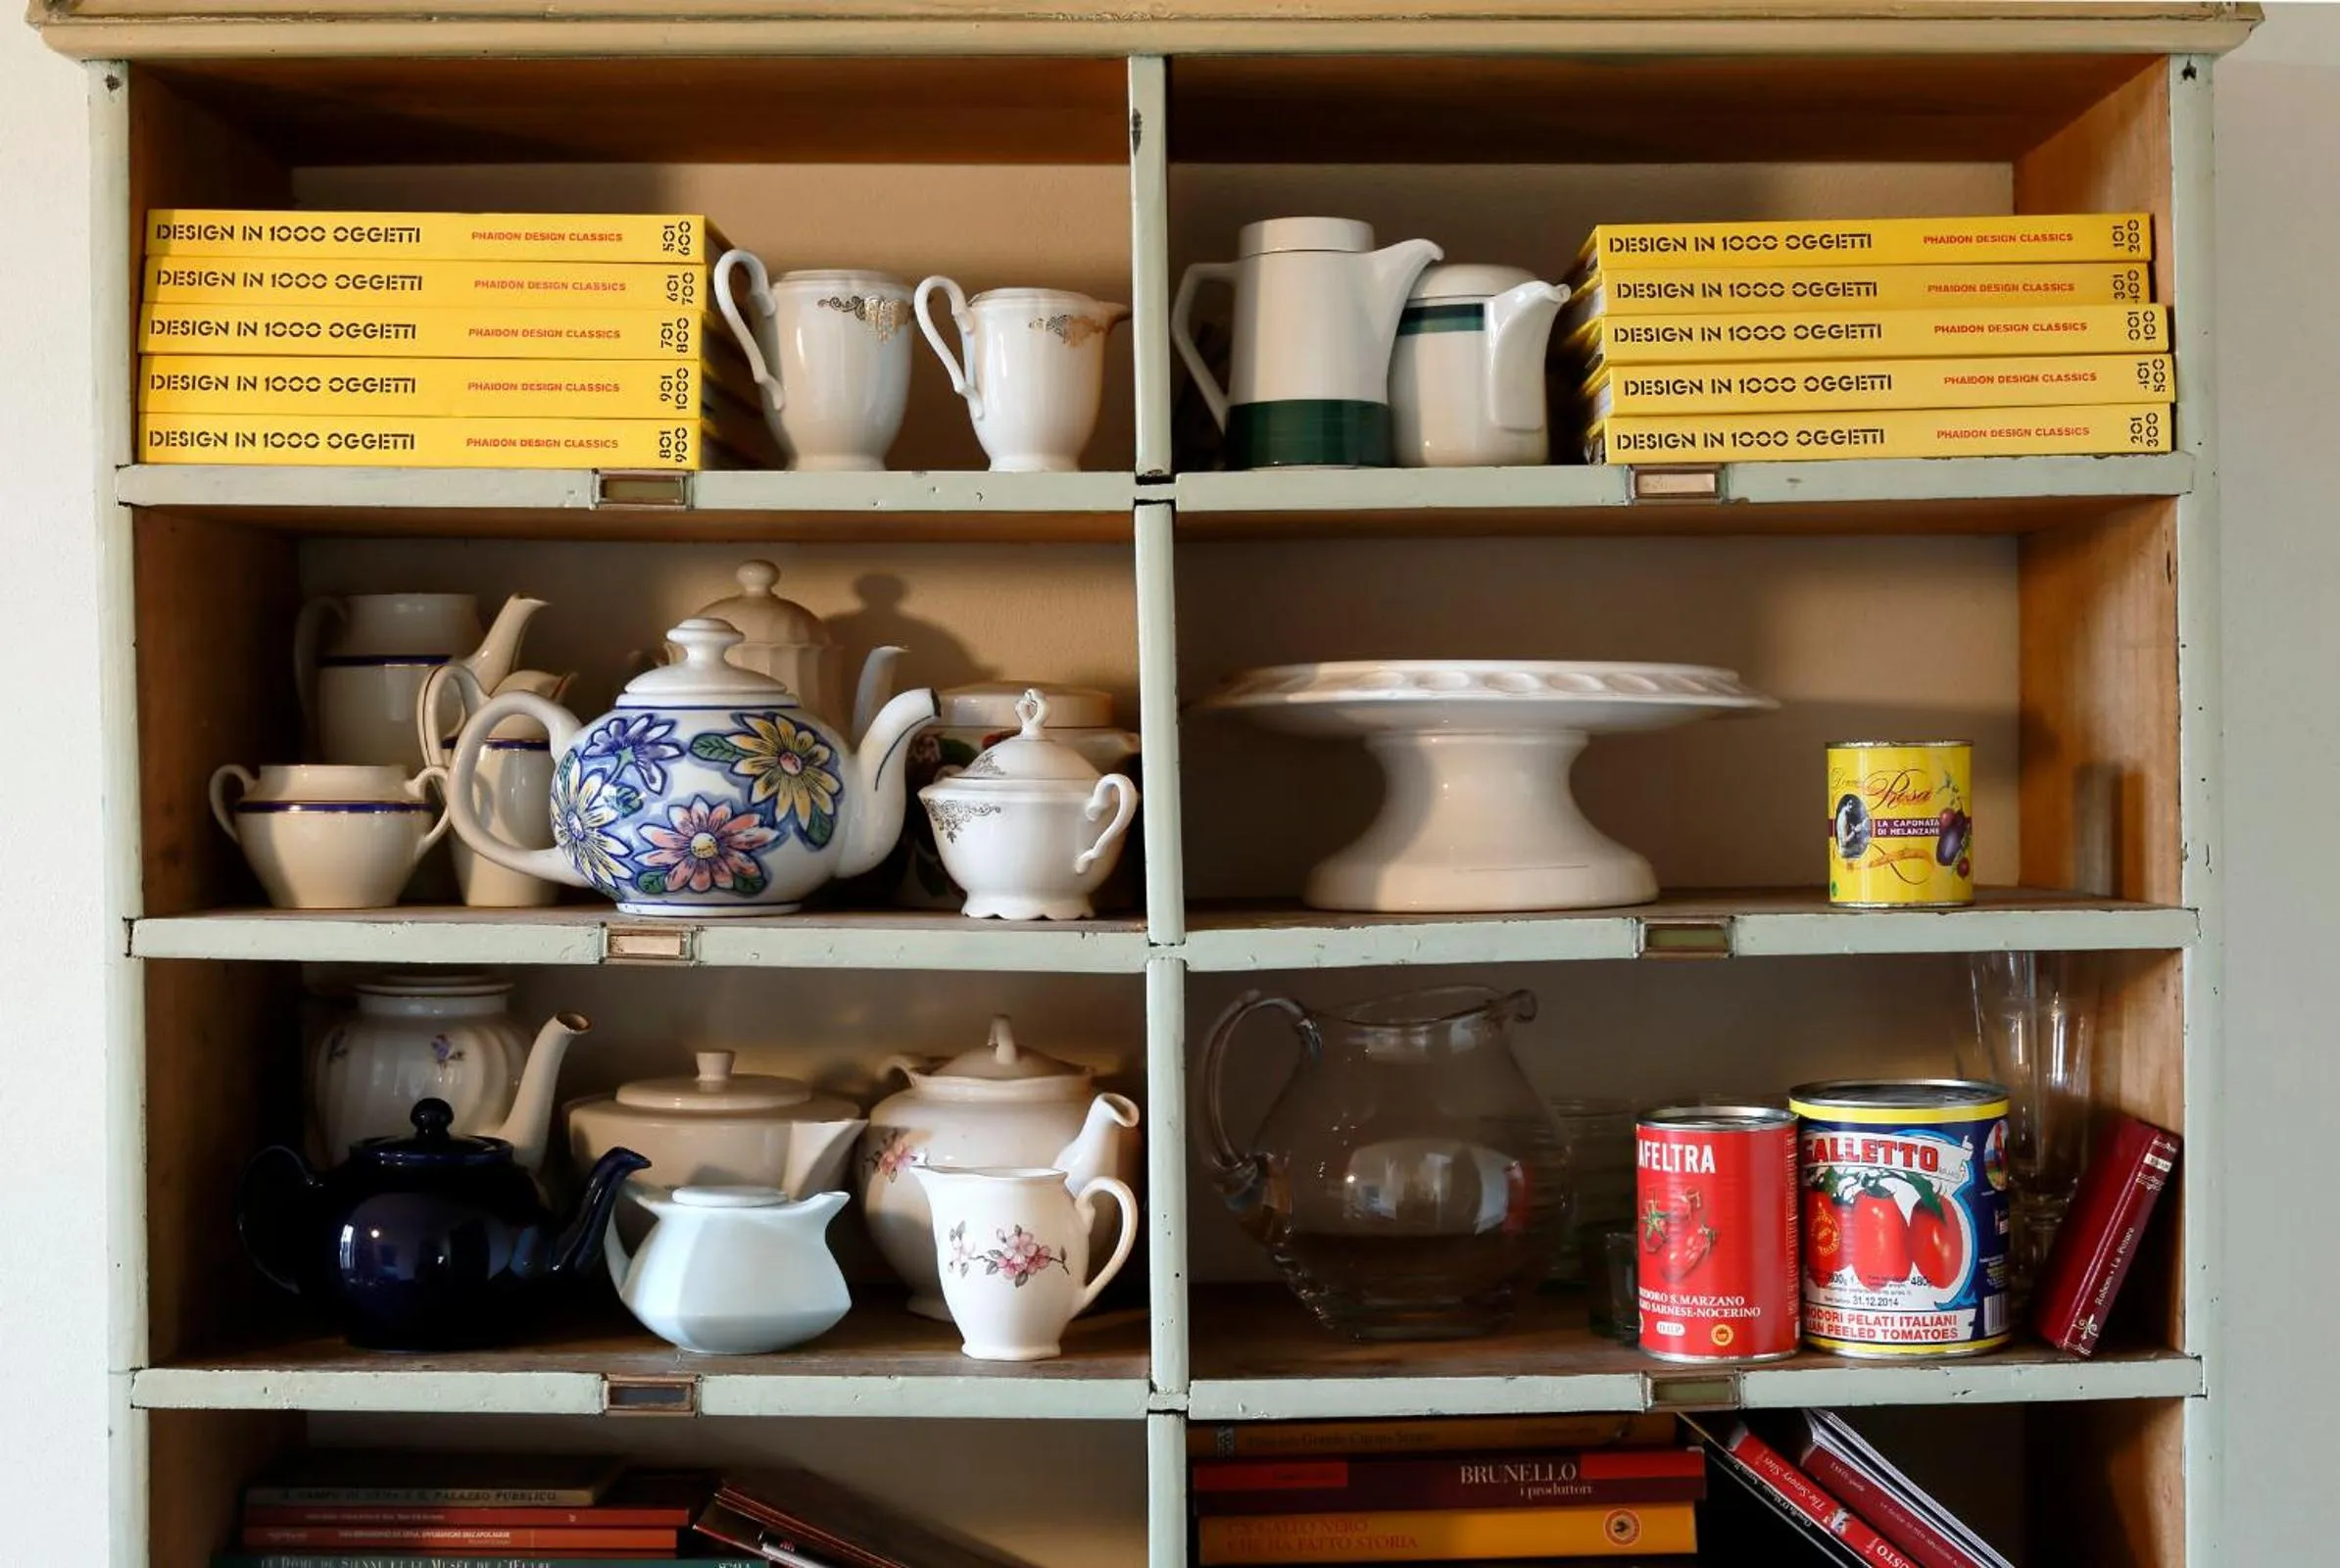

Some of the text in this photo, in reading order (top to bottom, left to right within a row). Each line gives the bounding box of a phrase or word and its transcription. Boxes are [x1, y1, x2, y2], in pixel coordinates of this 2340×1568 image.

[157, 223, 419, 242] DESIGN IN 1000 OGGETTI
[525, 232, 564, 241] DESIGN
[663, 225, 675, 251] 501
[678, 221, 691, 256] 600
[1610, 233, 1872, 252] DESIGN IN 1000 OGGETTI
[1924, 235, 1973, 244] PHAIDON
[2020, 233, 2073, 242] CLASSICS
[2113, 225, 2124, 247] 101
[2127, 220, 2140, 252] 200
[157, 269, 422, 290] DESIGN IN 1000 OGGETTI
[474, 280, 524, 289] PHAIDON
[572, 282, 626, 291] CLASSICS
[667, 275, 678, 301] 601
[682, 272, 694, 305] 700
[1979, 283, 2019, 292] DESIGN
[2113, 274, 2125, 299] 301
[1618, 282, 1877, 298] DESIGN IN 1000 OGGETTI
[151, 319, 415, 339] DESIGN IN 1000 OGGETTI
[469, 328, 518, 337] PHAIDON
[661, 323, 672, 348] 701
[676, 318, 689, 353] 800
[1615, 324, 1881, 342] DESIGN IN 1000 OGGETTI
[2032, 322, 2087, 331] CLASSICS
[2127, 312, 2140, 340] 001
[2143, 311, 2156, 340] 100
[151, 374, 415, 393] DESIGN IN 1000 OGGETTI
[1625, 374, 1891, 396] DESIGN IN 1000 OGGETTI
[1944, 372, 2097, 384] PHAIDON DESIGN CLASSICS
[2153, 359, 2166, 392] 500
[565, 383, 619, 392] CLASSICS
[659, 375, 672, 402] 901
[675, 368, 688, 410] 1000
[150, 430, 414, 450] DESIGN IN 1000 OGGETTI
[1618, 429, 1884, 450] DESIGN IN 1000 OGGETTI
[1937, 427, 2089, 439] PHAIDON DESIGN CLASSICS
[2130, 417, 2142, 443] 201
[2146, 413, 2159, 447] 300
[466, 438, 516, 447] PHAIDON
[564, 439, 617, 448] CLASSICS
[659, 431, 671, 459] 801
[675, 427, 687, 463] 900
[1638, 1139, 1716, 1174] AFELTRA
[1853, 1295, 1899, 1307] 31.12.2014
[1848, 1312, 1894, 1327] PELATI
[1899, 1314, 1958, 1327] ITALIANI
[1828, 1324, 1877, 1339] PEELED
[1881, 1327, 1958, 1341] TOMATOES
[1460, 1463, 1577, 1484] BRUNELLO
[496, 1491, 557, 1500] PUBBLICO
[1320, 1519, 1368, 1532] NERO
[1297, 1537, 1351, 1550] FATTO
[1356, 1535, 1418, 1549] STORIA
